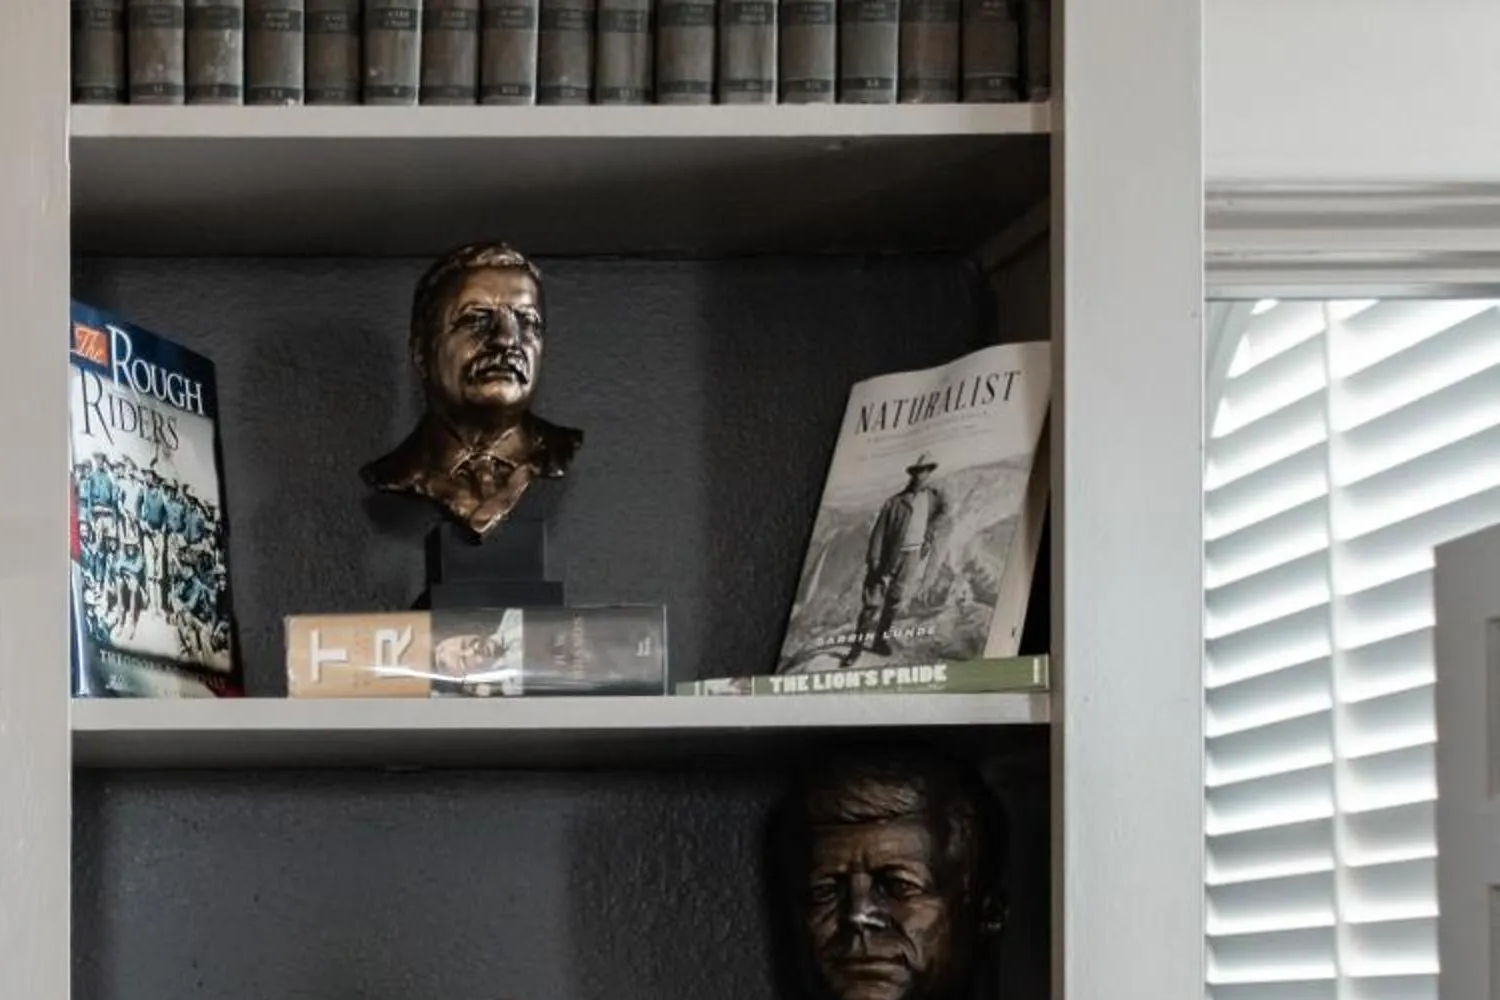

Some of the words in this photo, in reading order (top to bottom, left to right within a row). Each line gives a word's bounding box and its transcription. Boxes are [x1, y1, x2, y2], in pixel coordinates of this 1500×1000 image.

[75, 326, 106, 363] The
[106, 324, 205, 416] ROUGH
[853, 370, 1021, 435] NATURALIST
[80, 367, 180, 452] RIDERS
[769, 671, 811, 694] THE
[813, 669, 878, 690] LION'S
[881, 664, 948, 686] PRIDE
